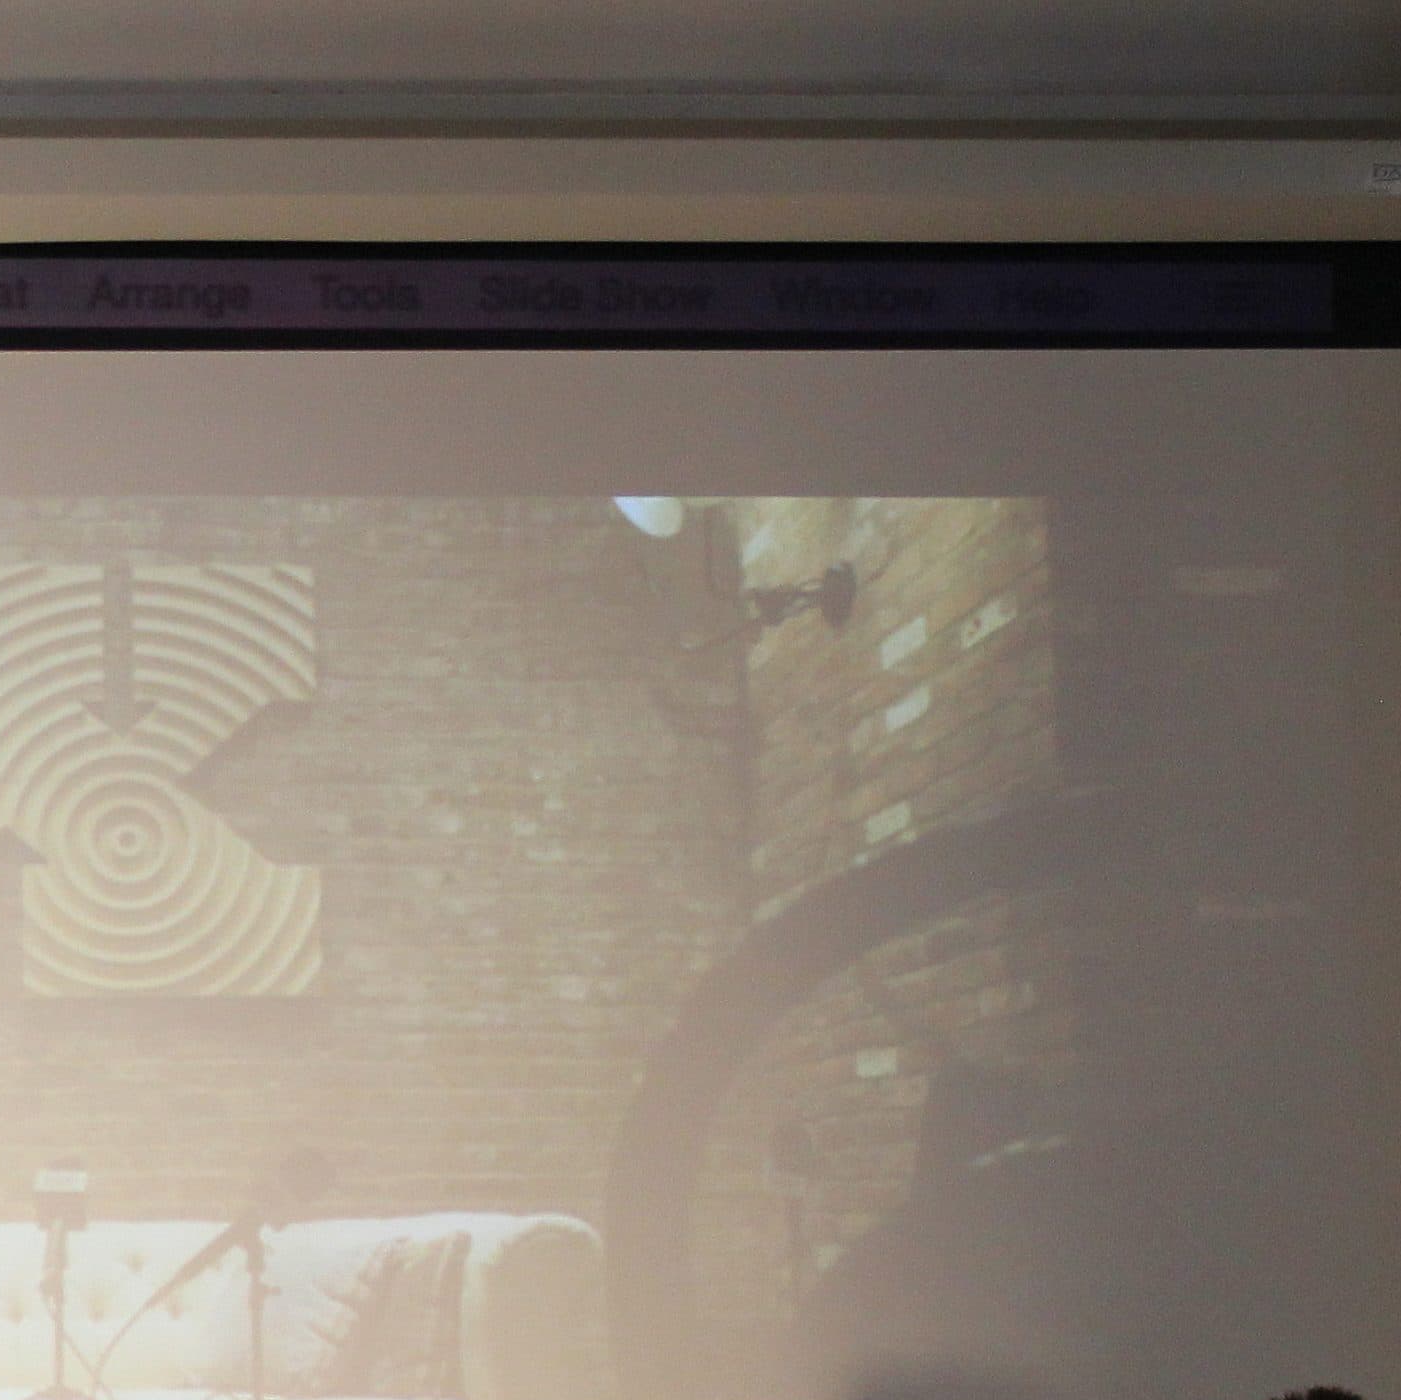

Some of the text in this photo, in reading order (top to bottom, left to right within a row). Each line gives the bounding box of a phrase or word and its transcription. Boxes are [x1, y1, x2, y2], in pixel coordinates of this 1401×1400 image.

[85, 273, 252, 319] Arrange
[311, 273, 424, 312] Tools
[478, 274, 582, 313] Slide
[595, 275, 714, 314] Show
